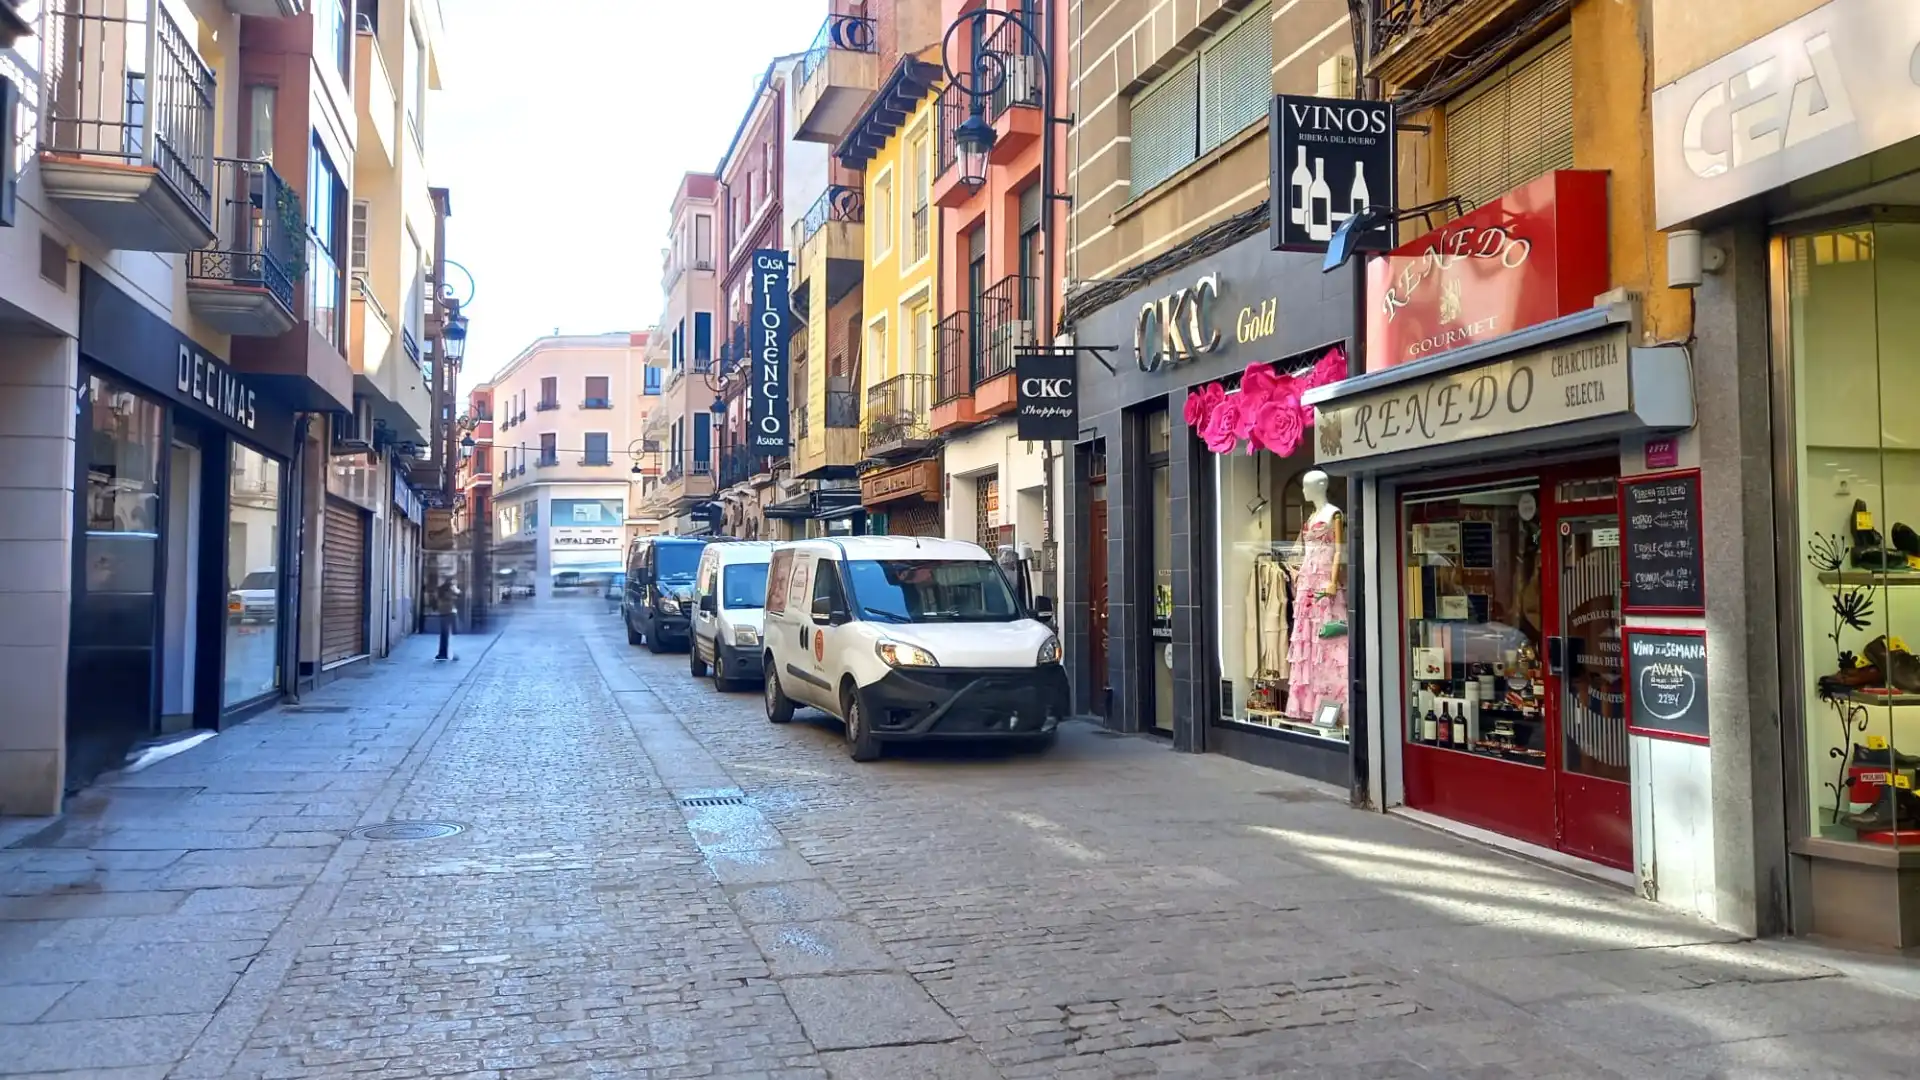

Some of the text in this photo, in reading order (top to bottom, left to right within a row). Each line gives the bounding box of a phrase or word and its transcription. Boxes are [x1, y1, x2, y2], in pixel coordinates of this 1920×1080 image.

[1289, 103, 1386, 134] VINOS
[1682, 31, 1856, 179] CEA
[1299, 132, 1376, 146] RIBERA DEL DUERO
[757, 256, 785, 271] CASA
[1382, 226, 1531, 324] RENEDO
[1134, 271, 1278, 373] CKC Gold
[1409, 315, 1499, 356] GOURMET
[761, 272, 781, 434] FLORENCIO
[1551, 342, 1619, 378] CHARCUTERIA
[178, 343, 256, 430] DECIMAS
[1021, 378, 1073, 399] CKC
[1565, 380, 1605, 408] SELECTA
[1021, 403, 1074, 419] Shopping
[1352, 365, 1535, 450] RENEDO
[756, 435, 784, 446] ASADOR
[1599, 641, 1621, 653] VINOS
[1665, 642, 1706, 659] SEMANA
[1651, 662, 1684, 677] AVAN
